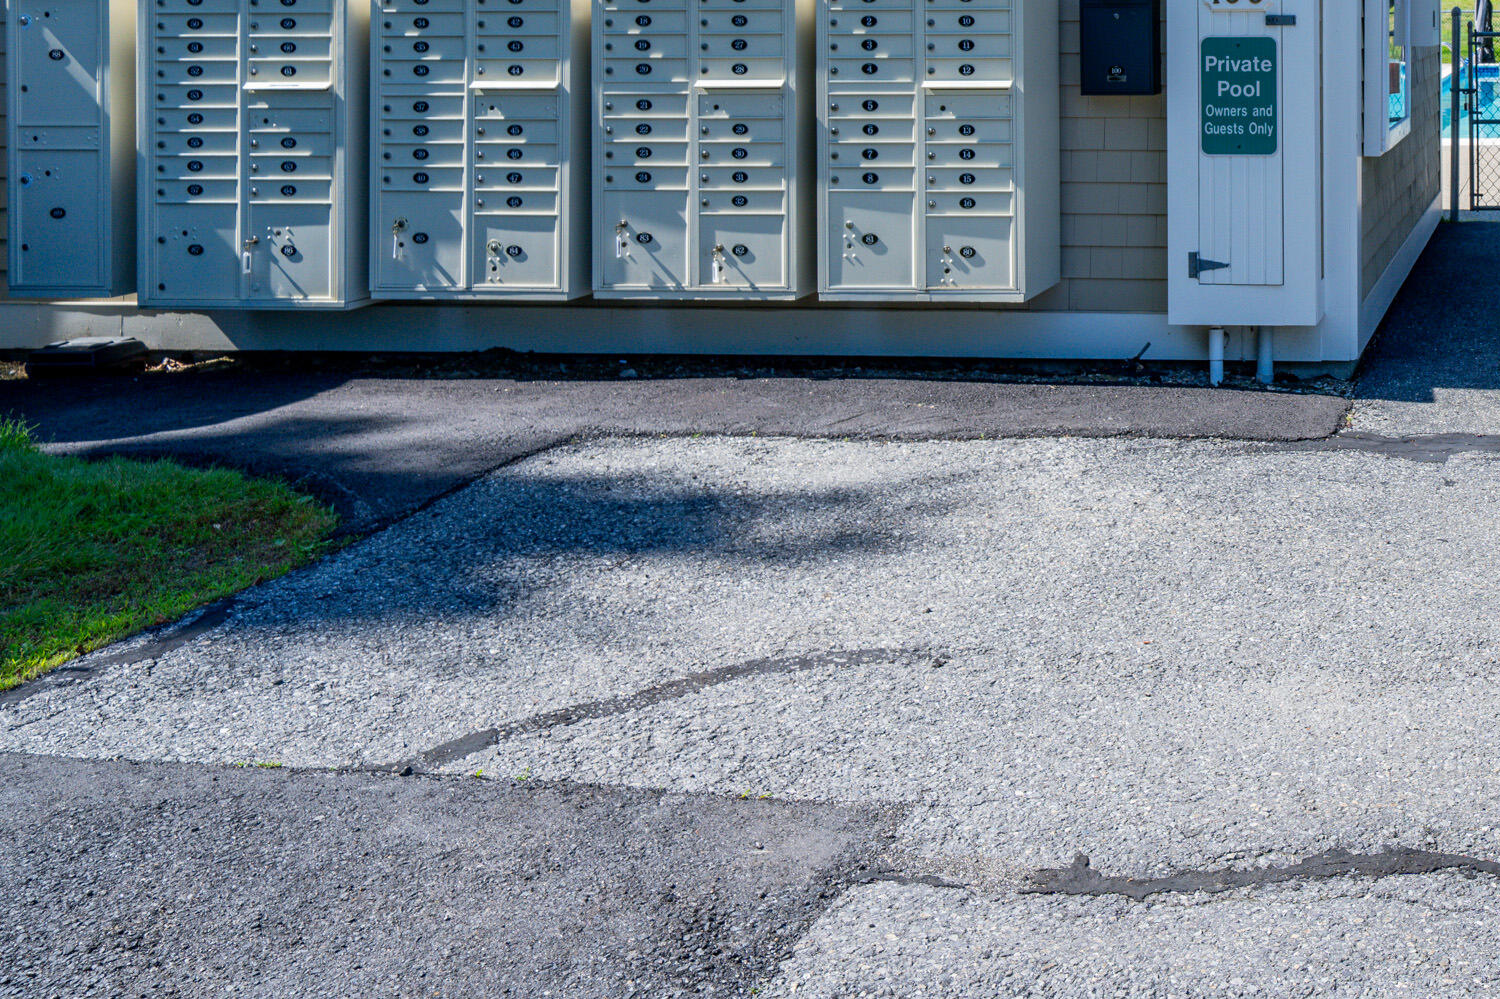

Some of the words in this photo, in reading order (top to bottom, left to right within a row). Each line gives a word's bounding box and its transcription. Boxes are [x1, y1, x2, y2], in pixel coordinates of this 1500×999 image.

[962, 17, 971, 25] 10
[962, 41, 971, 50] 11
[1205, 56, 1272, 72] Private
[511, 66, 520, 75] 44
[962, 66, 971, 74] 12
[1112, 66, 1121, 74] 100
[1218, 80, 1260, 97] Pool
[1206, 104, 1247, 117] Owners
[1252, 104, 1273, 117] and
[962, 126, 971, 134] 13
[1204, 122, 1244, 135] Guests
[1249, 122, 1273, 136] Only
[962, 150, 972, 159] 14
[962, 175, 972, 183] 15
[963, 199, 972, 207] 16
[640, 234, 649, 243] 83
[865, 235, 874, 244] 81
[735, 246, 744, 255] 82
[963, 248, 972, 257] 80
